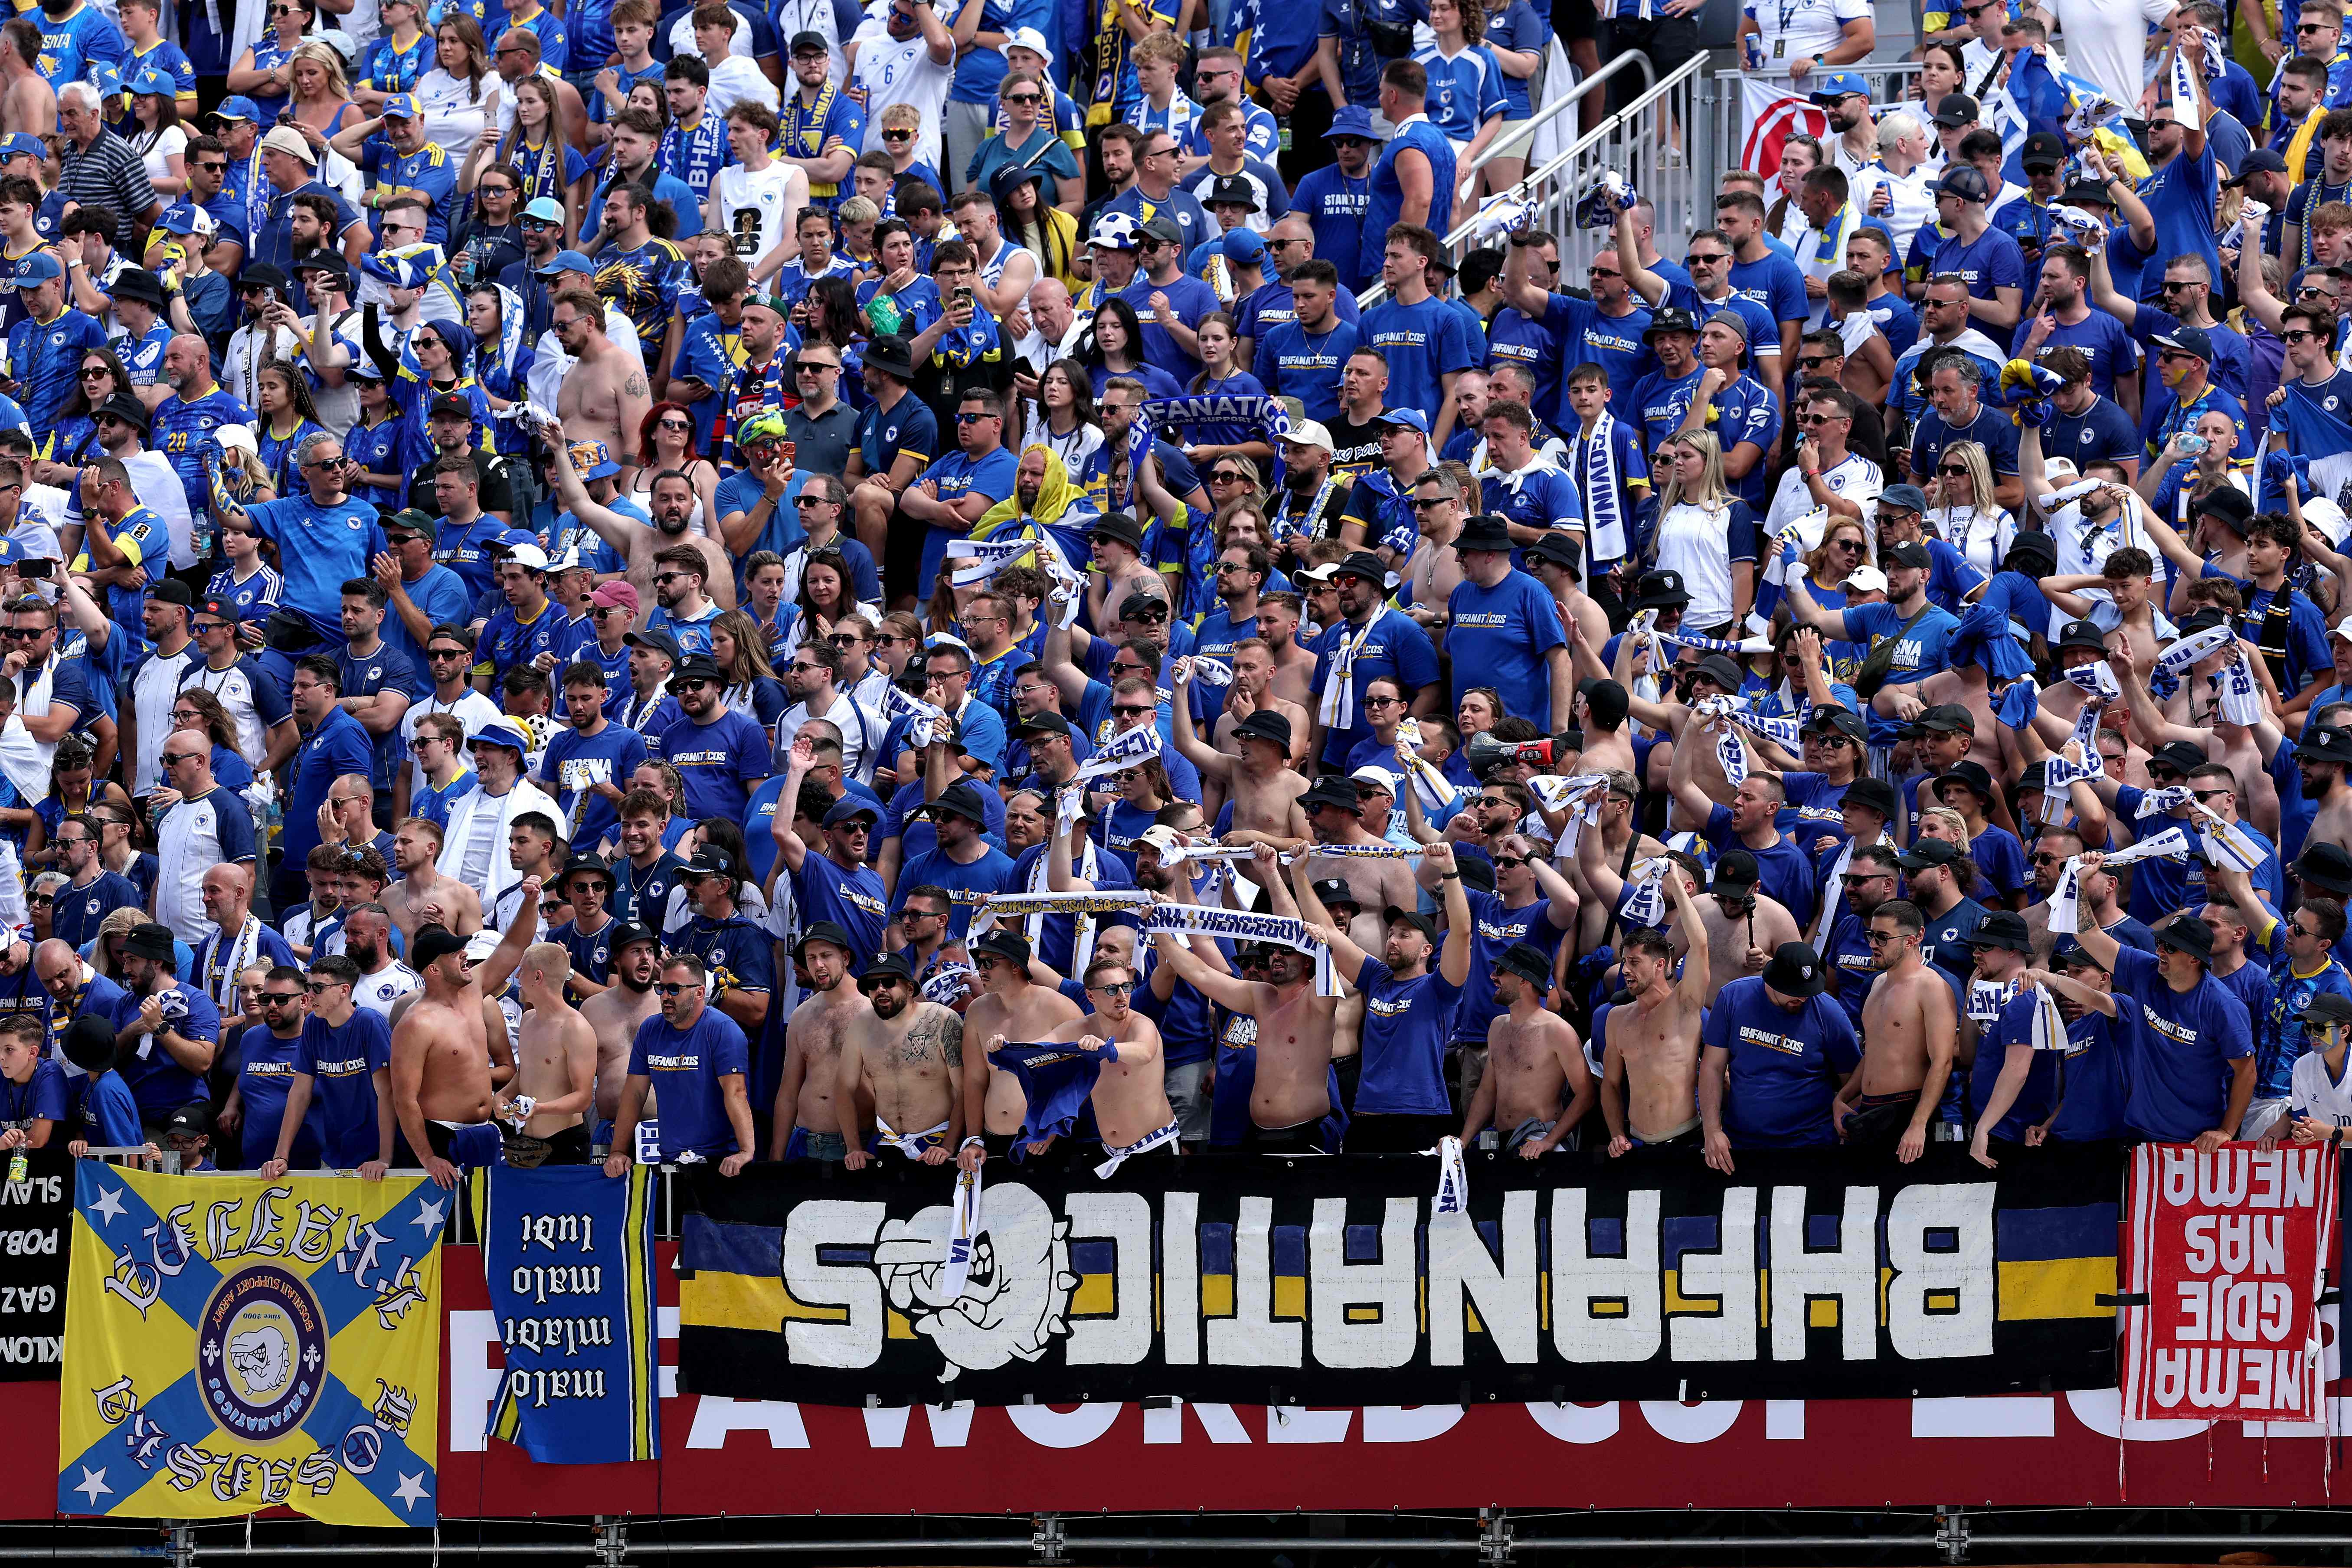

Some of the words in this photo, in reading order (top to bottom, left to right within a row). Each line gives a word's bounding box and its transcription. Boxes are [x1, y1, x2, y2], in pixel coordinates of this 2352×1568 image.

[40, 33, 72, 49] SNIA
[384, 73, 399, 92] 11
[884, 64, 893, 84] 6
[442, 102, 457, 117] 7
[1439, 106, 1454, 124] 9
[1324, 194, 1355, 206] STAND
[1372, 331, 1426, 345] BHFANATICOS
[1279, 354, 1338, 366] BHFANATICOS
[1491, 342, 1539, 359] BHFANATICOS
[1148, 416, 1198, 432] BOSNIAN
[1200, 416, 1252, 425] SUPPORT
[1257, 419, 1274, 436] ARMY
[168, 432, 187, 452] 20
[1455, 612, 1507, 624] BHFANATICOS
[1891, 655, 1919, 667] GOVINA
[603, 670, 620, 679] GEA
[671, 751, 726, 763] BHFANATICOS
[628, 897, 640, 921] 5
[1200, 909, 1317, 951] HERCEGOV
[2143, 1003, 2197, 1039] BHFANATICOS
[1739, 1025, 1804, 1054] BHFANATICOS
[648, 1054, 699, 1067] BHFANATICOS
[2163, 1148, 2318, 1209] NEMA
[2183, 1214, 2286, 1276] NAS
[236, 1275, 281, 1297] SUPPORT
[513, 1265, 602, 1303] malo
[212, 1289, 236, 1331] ARMY
[243, 1312, 261, 1320] 2000
[263, 1313, 281, 1321] since
[280, 1282, 314, 1333] BOSNIAN
[511, 1370, 606, 1407] malo
[2153, 1347, 2303, 1411] NEMA
[209, 1378, 311, 1432] BHFANATICOS
